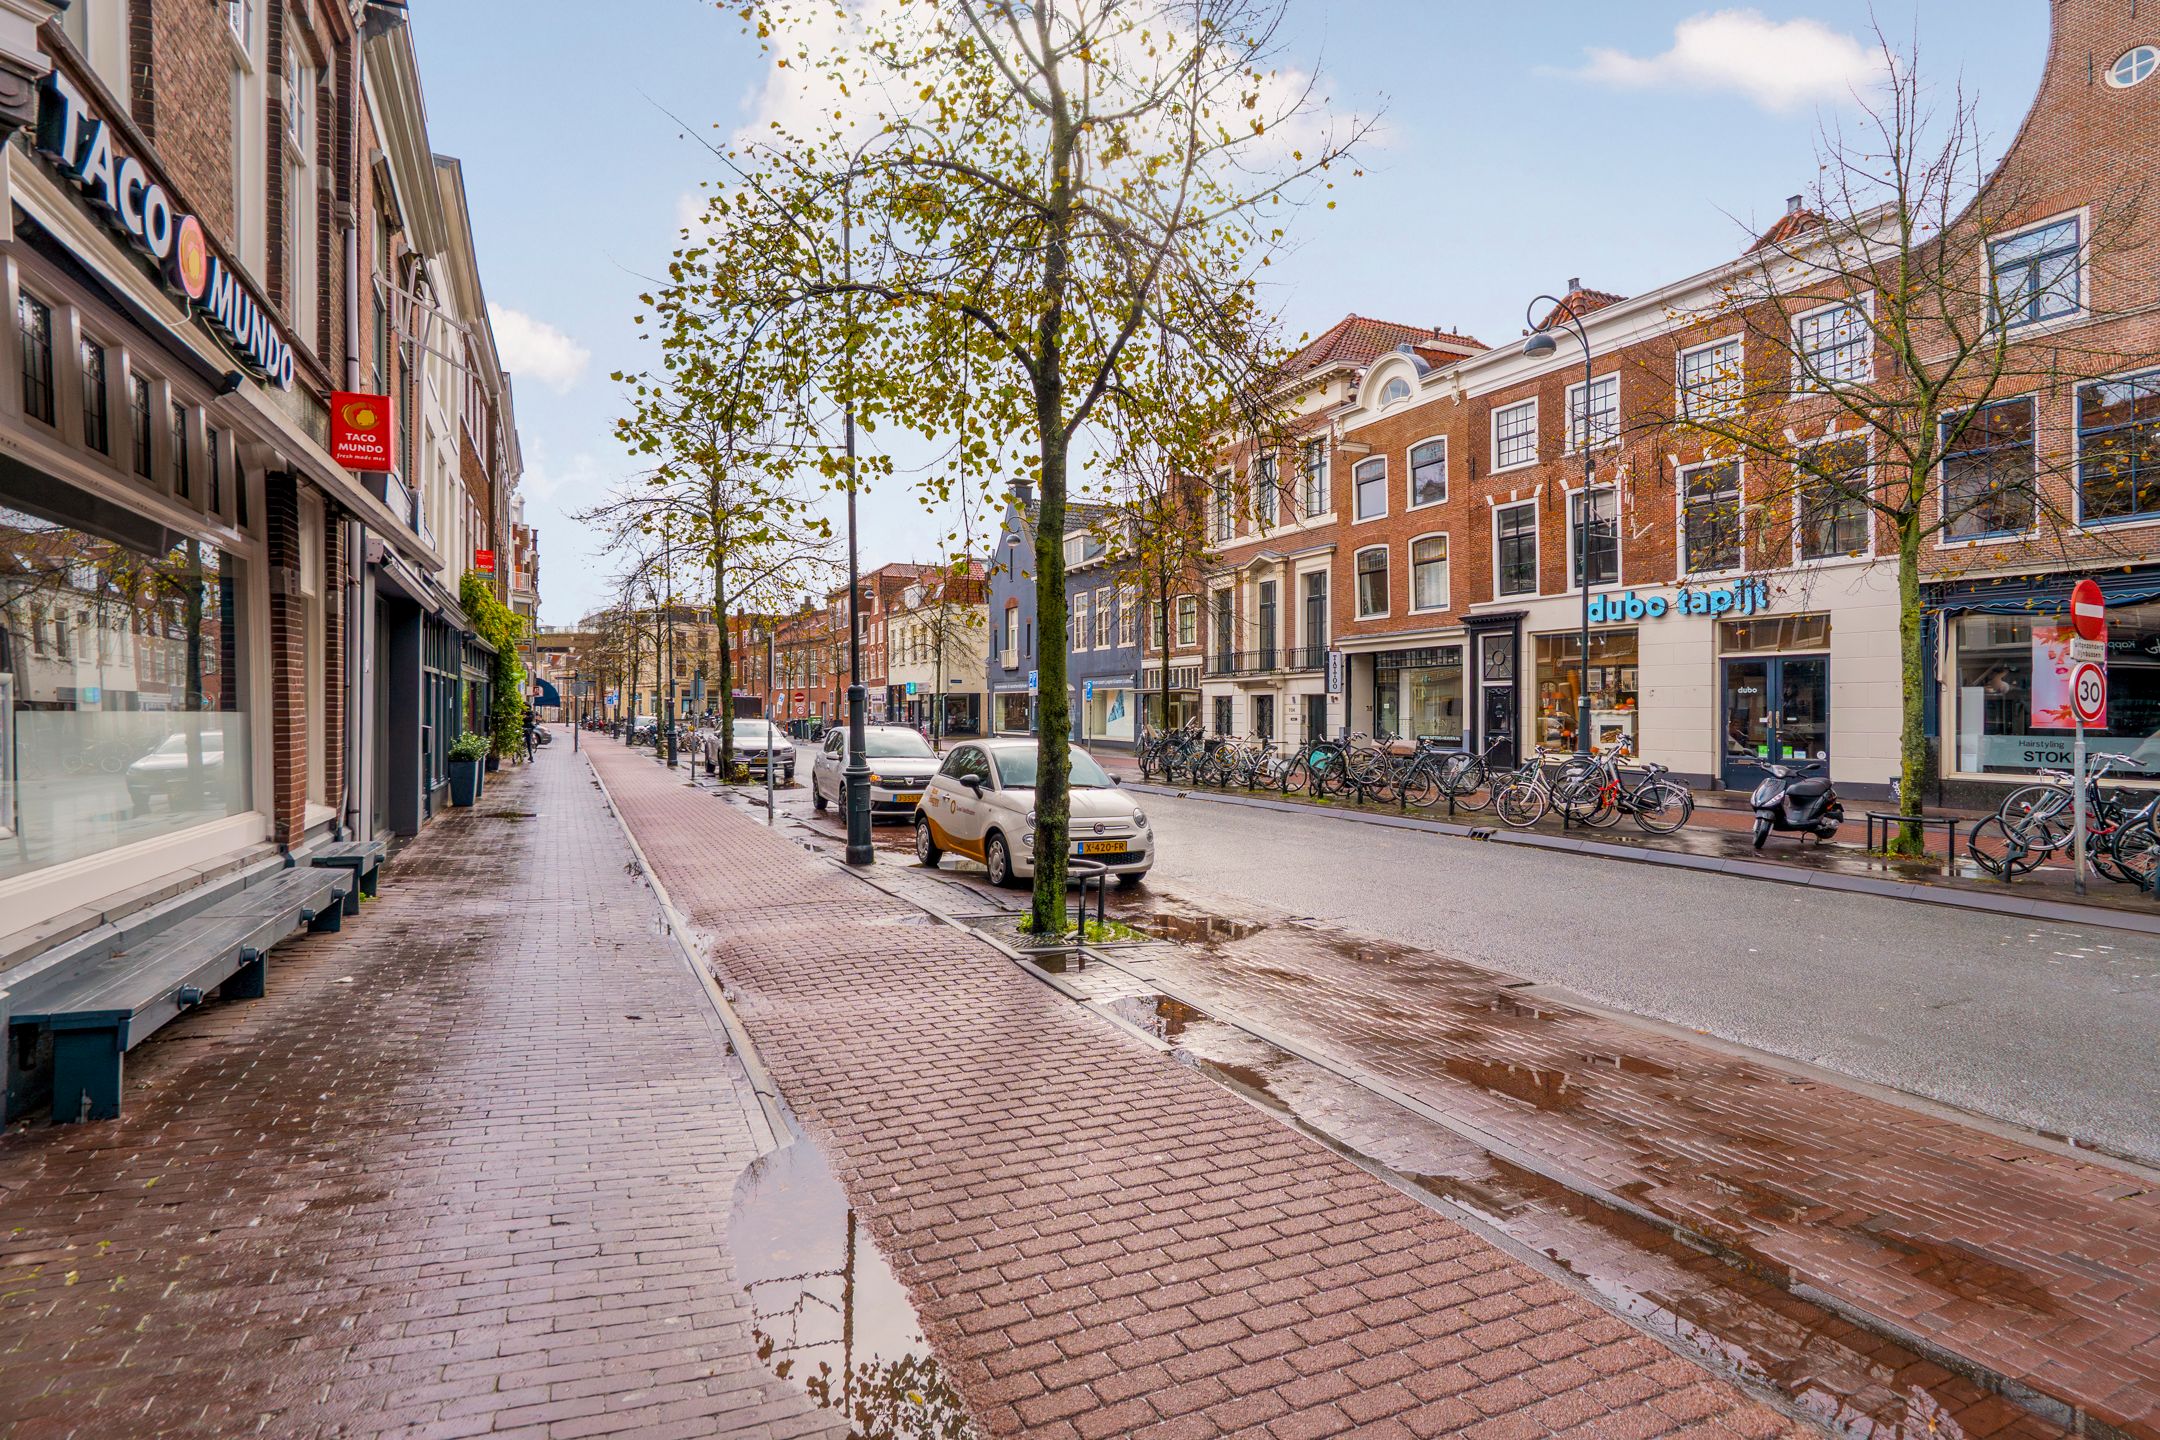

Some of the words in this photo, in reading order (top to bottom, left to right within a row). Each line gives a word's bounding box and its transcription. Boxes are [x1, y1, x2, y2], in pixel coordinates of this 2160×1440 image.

[54, 69, 173, 259] TACO
[208, 256, 294, 392] MUNDO
[345, 432, 377, 443] TACO
[338, 443, 384, 454] MUNDO
[1588, 591, 1667, 622] dubo
[1677, 578, 1767, 618] tapijt
[1737, 686, 1758, 694] dubo
[2080, 680, 2100, 703] 30
[2018, 739, 2065, 749] Hairstyling
[1086, 842, 1125, 853] X-420-FR
